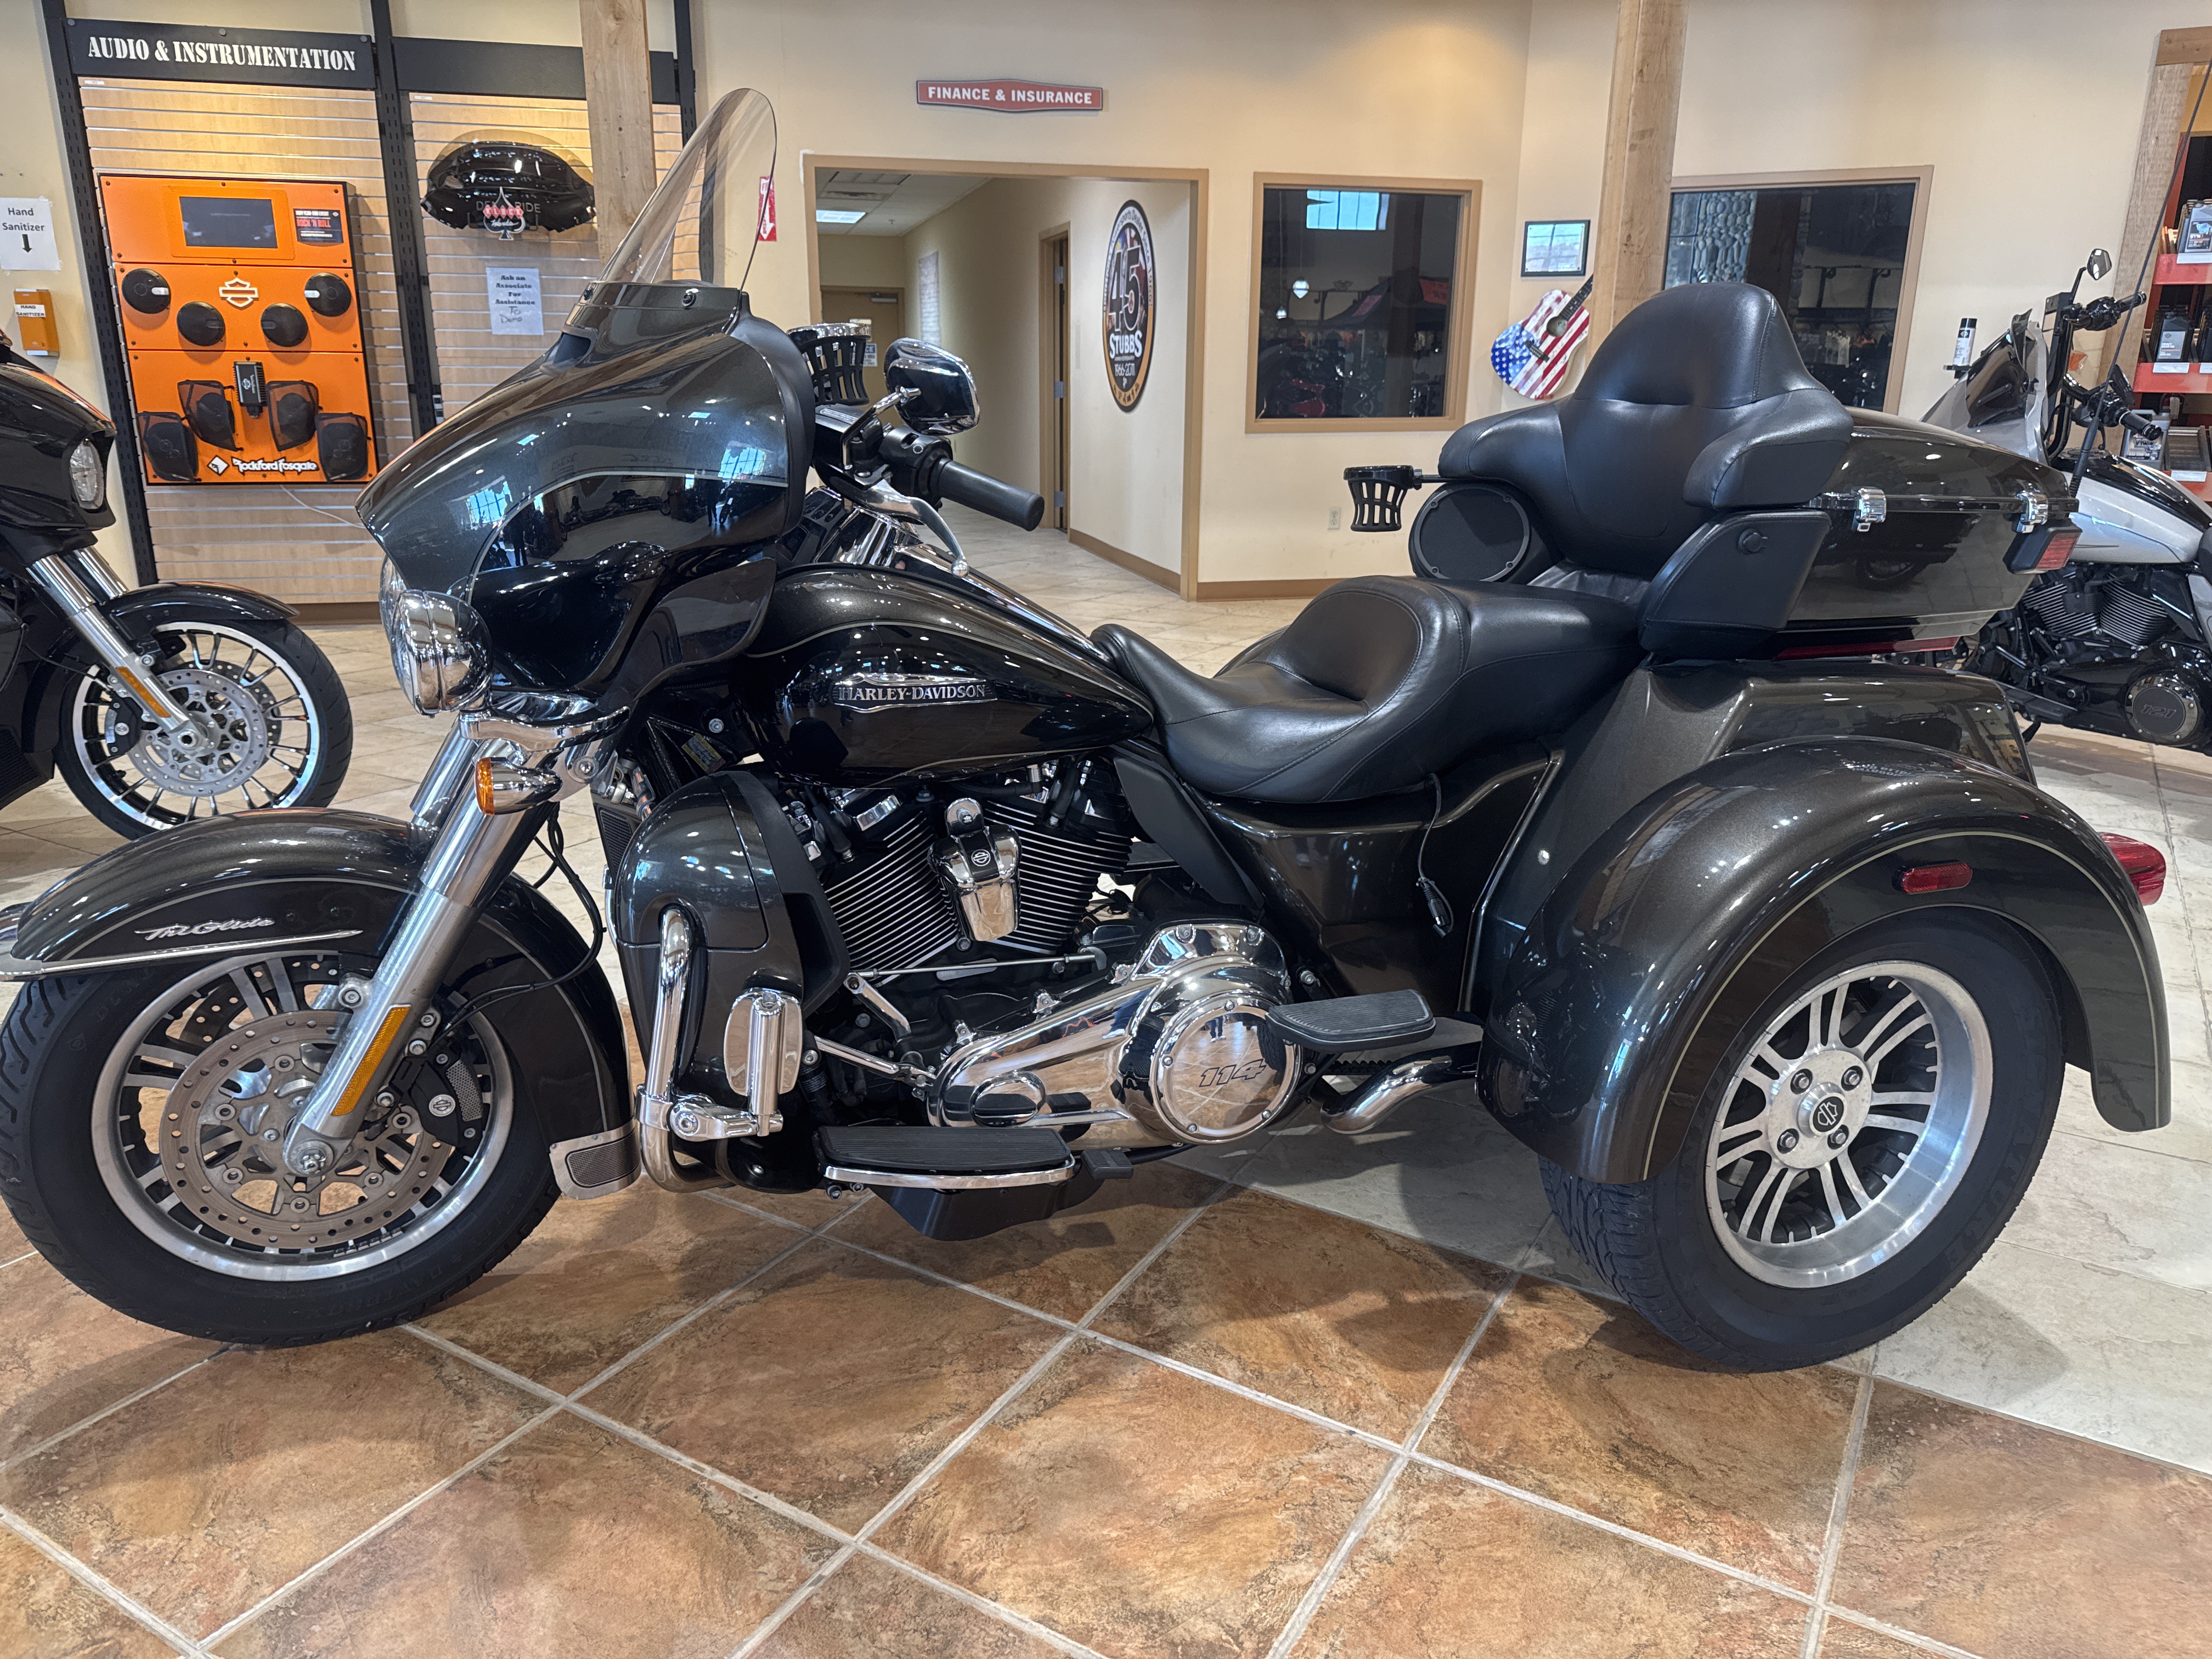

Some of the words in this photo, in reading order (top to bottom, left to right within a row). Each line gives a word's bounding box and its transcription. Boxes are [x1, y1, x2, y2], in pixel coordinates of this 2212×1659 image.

[88, 36, 149, 60] AUDIO
[155, 40, 170, 61] &
[172, 41, 356, 71] INSTRUMENTATION
[928, 87, 990, 100] FINANCE
[995, 89, 1006, 101] &
[1012, 89, 1092, 104] INSURANCE
[8, 207, 34, 216] Hand
[2, 222, 44, 232] Sanitizer
[1108, 245, 1141, 332] 45
[1109, 330, 1142, 359] STUBBS
[1114, 363, 1135, 376] 1966-2011
[838, 685, 985, 700] HARLEY-DAVIDSON
[2141, 704, 2177, 718] 121
[192, 917, 275, 934] Glide
[1199, 1058, 1267, 1087] 114
